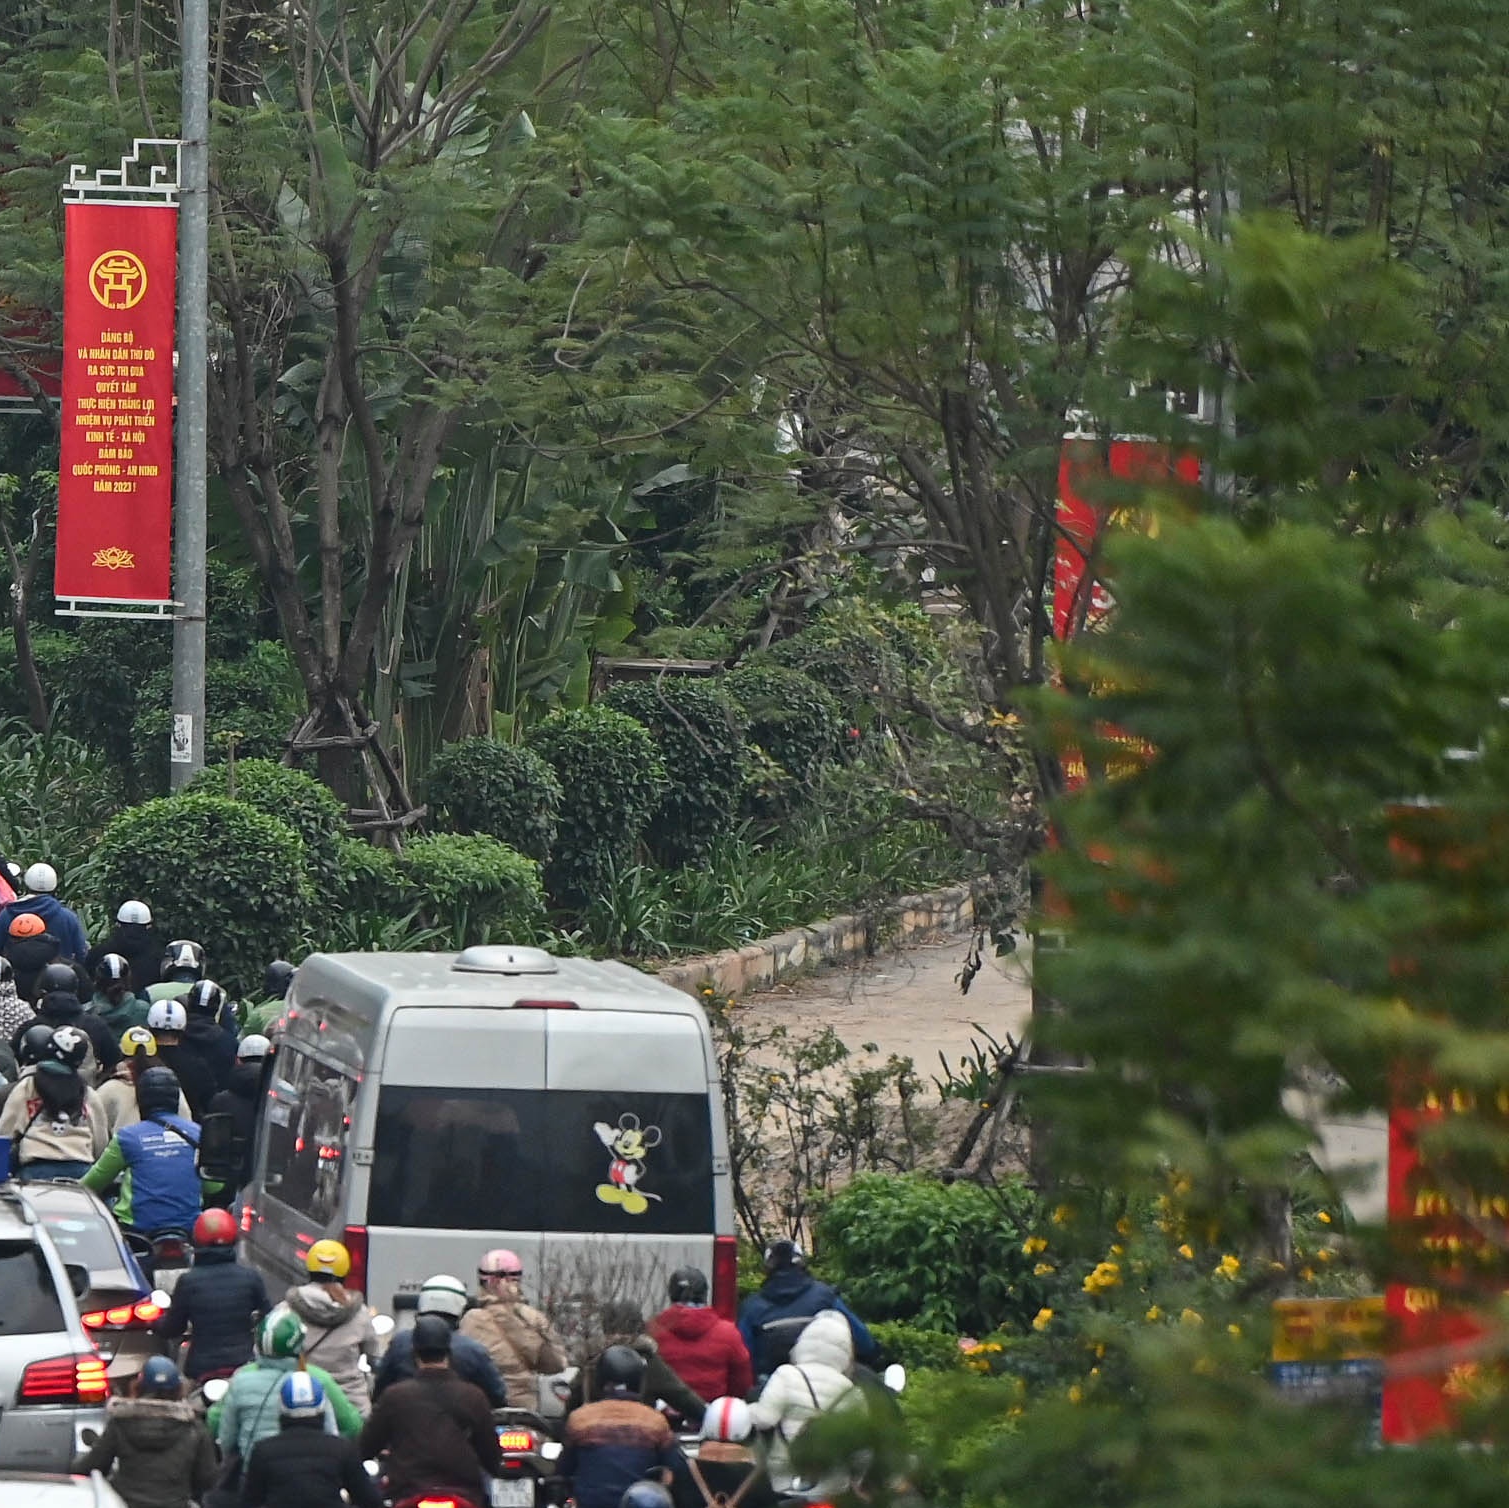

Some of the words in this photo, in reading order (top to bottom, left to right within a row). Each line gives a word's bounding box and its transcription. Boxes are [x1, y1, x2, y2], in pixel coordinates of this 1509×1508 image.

[100, 328, 122, 343] ĐẢNG
[123, 330, 134, 346] BỘ
[77, 346, 88, 360] VÀ
[89, 348, 111, 361] NHÂN
[130, 345, 144, 361] THỦ
[87, 364, 98, 377] RA
[99, 363, 116, 377] SỨC
[117, 365, 129, 377] THI
[95, 378, 120, 394] QUYẾT
[77, 398, 97, 412] THỰC
[97, 397, 116, 412] HIỆN
[75, 412, 101, 428] NHIỆM
[101, 415, 113, 428] VỤ
[113, 413, 133, 427] PHÁT
[85, 431, 104, 443] KINH
[105, 429, 115, 443] TẾ
[132, 430, 146, 445] HỘI
[117, 444, 134, 459] BẢO
[72, 461, 94, 476] QUỐC
[94, 463, 121, 476] PHÒNG
[126, 465, 138, 476] AN
[138, 465, 159, 477] NINH
[113, 481, 132, 493] 2023
